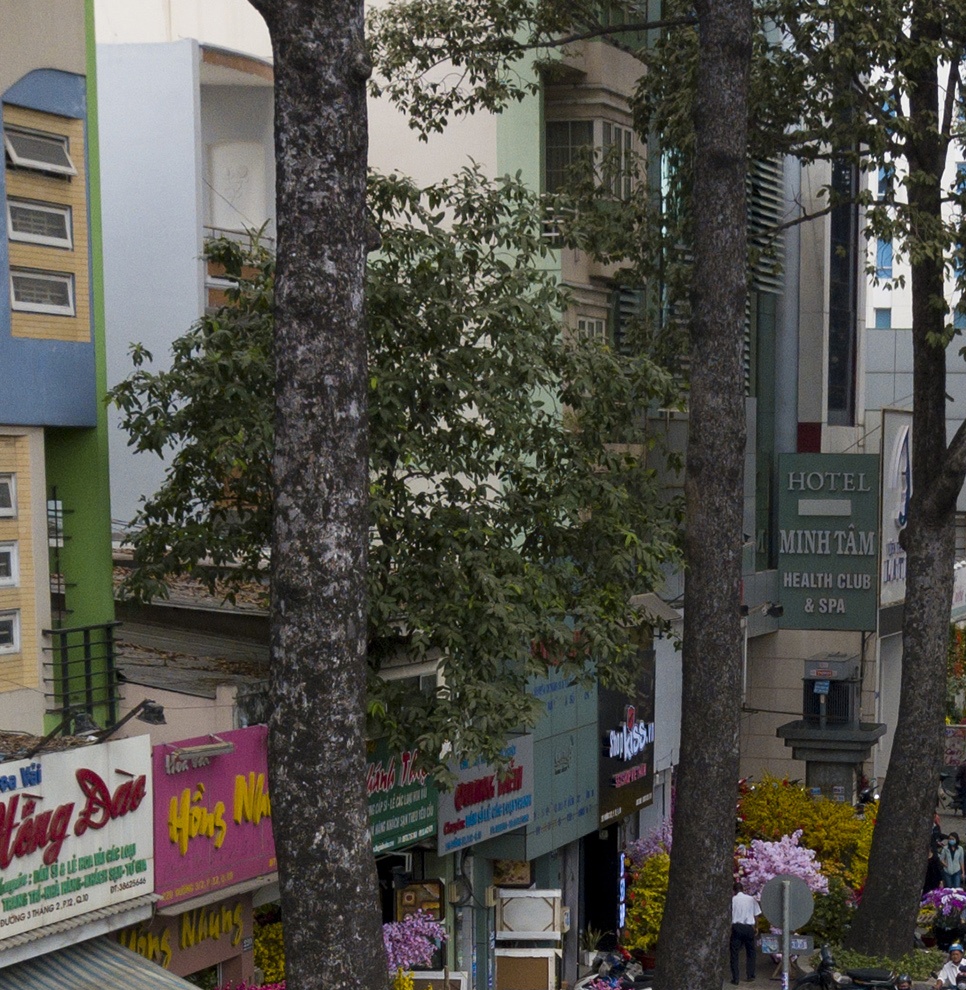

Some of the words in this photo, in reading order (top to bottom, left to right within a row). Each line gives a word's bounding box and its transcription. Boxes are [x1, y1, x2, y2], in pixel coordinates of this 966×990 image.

[787, 471, 871, 492] HOTEL
[779, 529, 831, 555] MINH
[834, 523, 875, 556] TÂM
[783, 572, 833, 589] HEALTH
[837, 573, 871, 590] CLUB
[804, 597, 814, 613] &
[818, 598, 846, 614] SPA
[74, 768, 147, 837] Đào
[167, 782, 228, 858] Hồng
